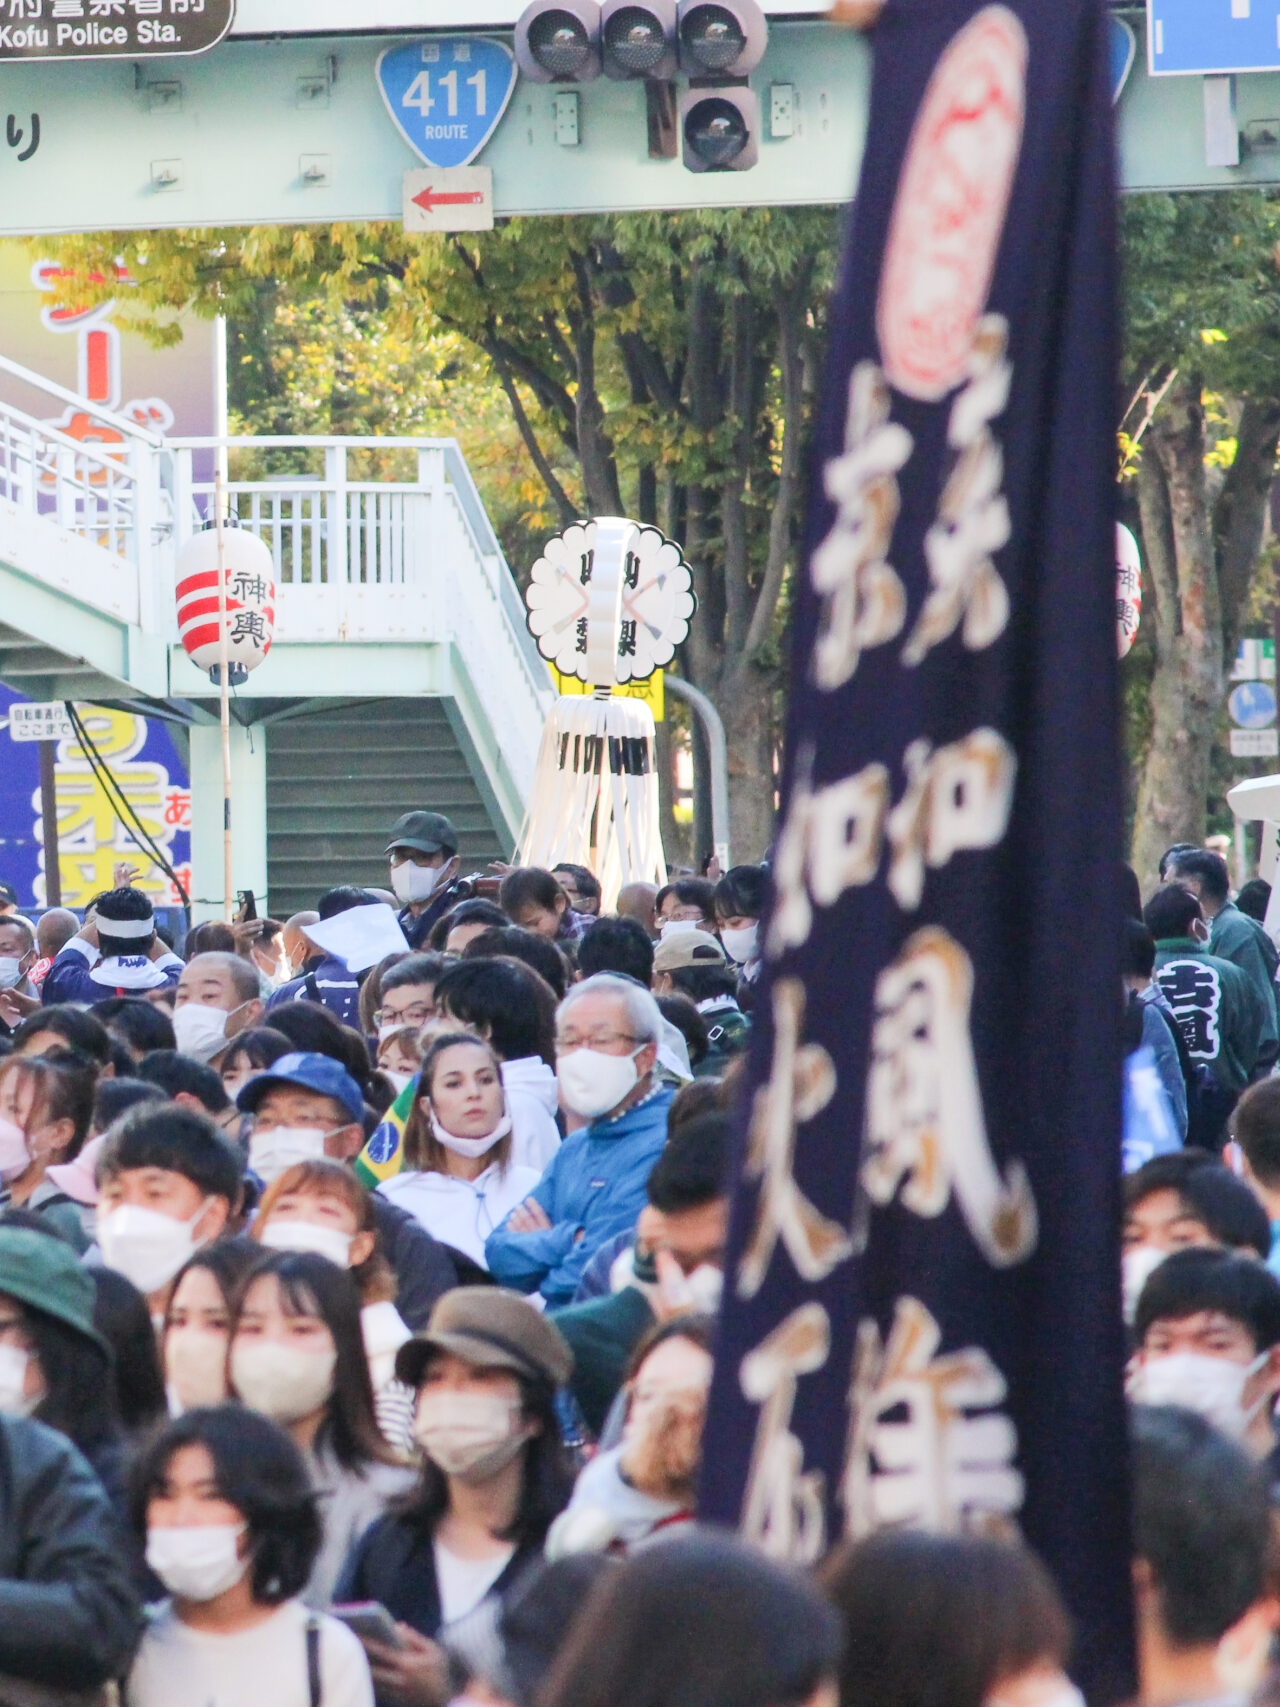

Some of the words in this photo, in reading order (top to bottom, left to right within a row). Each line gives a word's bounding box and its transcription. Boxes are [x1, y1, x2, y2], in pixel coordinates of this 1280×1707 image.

[57, 21, 128, 47] Police
[136, 19, 182, 44] Sta.
[402, 69, 486, 117] 411
[425, 124, 469, 139] ROUTE
